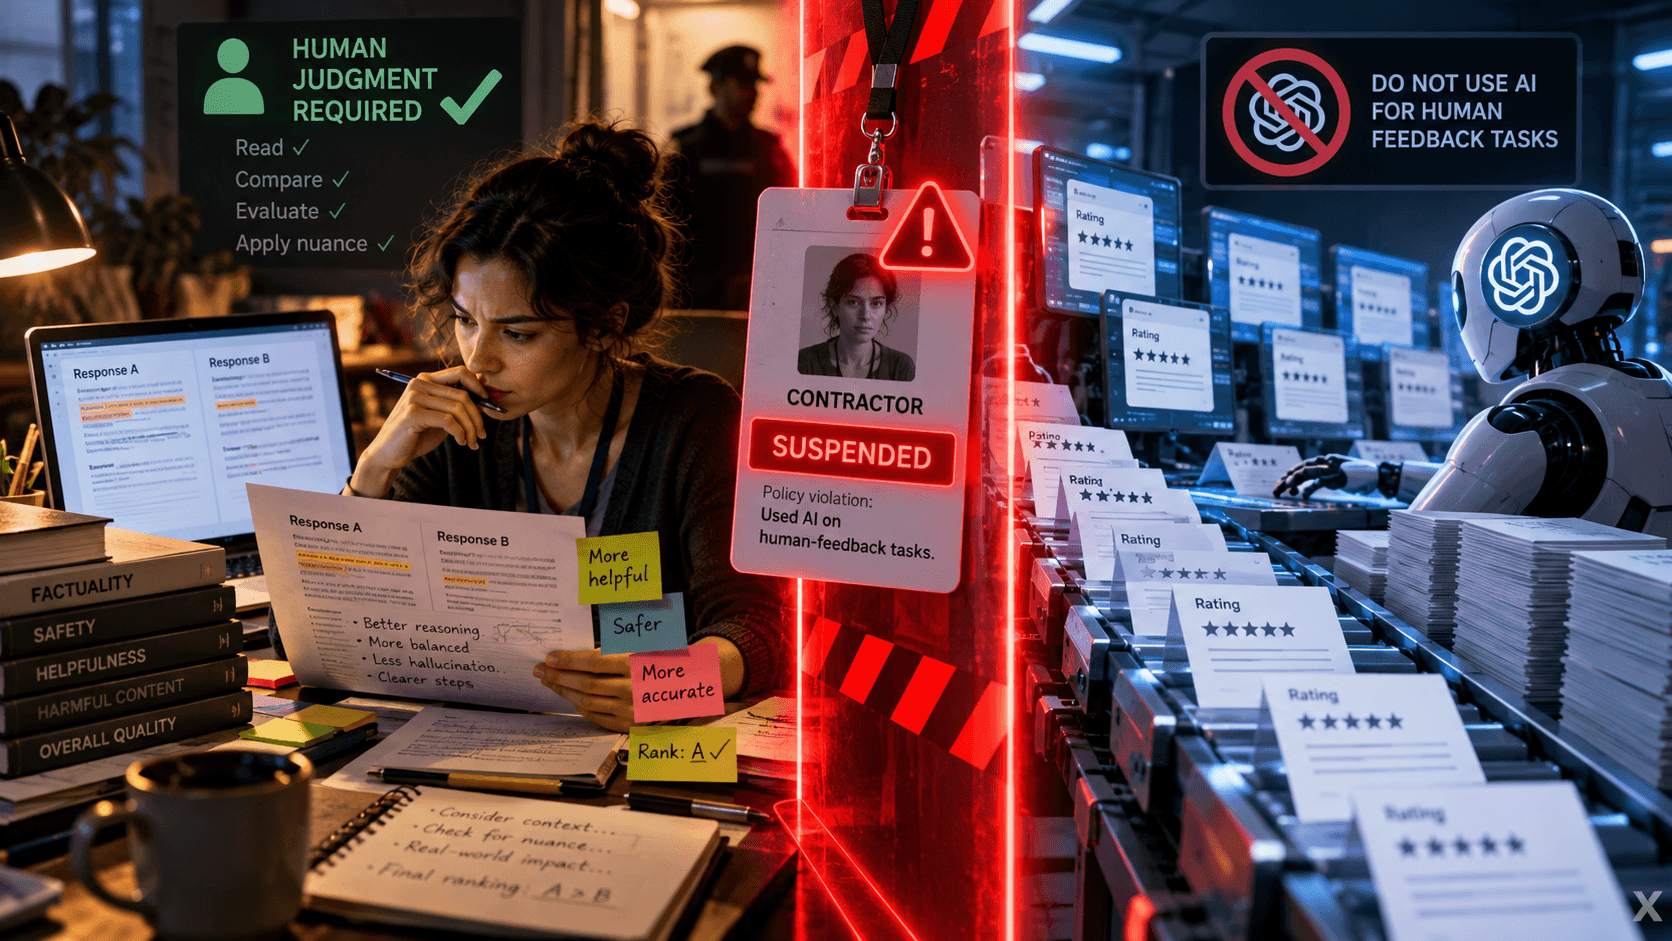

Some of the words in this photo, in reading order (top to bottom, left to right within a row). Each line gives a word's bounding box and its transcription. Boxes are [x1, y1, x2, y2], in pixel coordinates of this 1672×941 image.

[293, 37, 386, 59] HUMAN
[293, 68, 438, 90] JUDGMENT
[1372, 74, 1404, 92] DO
[1412, 74, 1458, 92] NOT
[1466, 74, 1508, 92] USE
[1514, 74, 1536, 92] AI
[293, 99, 422, 124] REQUIRED
[1372, 102, 1415, 120] FOR
[1421, 102, 1502, 120] HUMAN
[236, 138, 284, 156] Read
[1372, 130, 1484, 148] FEEDBACK
[1492, 130, 1558, 148] TASKS
[235, 170, 323, 191] Compare
[236, 202, 319, 220] Evaluate
[1076, 210, 1104, 226] Rating
[236, 234, 290, 255] Apply
[297, 238, 368, 252] nuance
[1131, 328, 1160, 342] Rating
[209, 356, 259, 369] Response
[262, 353, 270, 364] B
[73, 367, 127, 380] Response
[130, 364, 139, 374] A
[787, 389, 923, 415] CONTRACTOR
[772, 435, 932, 470] SUSPENDED
[1069, 475, 1103, 487] Rating
[763, 485, 805, 503] Policy
[809, 489, 873, 508] violation:
[289, 514, 349, 533] Response
[352, 522, 362, 533] A
[761, 507, 798, 524] Used
[803, 511, 819, 526] AI
[822, 516, 841, 528] on
[437, 531, 497, 546] Response
[500, 536, 510, 547] B
[759, 530, 886, 555] human-feedback
[890, 541, 935, 560] tasks.
[1121, 533, 1161, 548] Rating
[589, 548, 629, 564] More
[589, 564, 648, 591] helpful
[31, 573, 134, 603] FACTUALITY
[1195, 597, 1240, 612] Rating
[34, 619, 96, 643] SAFETY
[363, 617, 407, 631] Better
[613, 614, 662, 637] Safer
[369, 636, 404, 649] More
[409, 638, 470, 653] balanced
[36, 648, 147, 682] HELPFULNESS
[372, 653, 402, 666] Less
[378, 671, 427, 684] Clearer
[435, 676, 474, 690] steps
[642, 664, 685, 681] More
[37, 693, 112, 720] HARMFUL
[115, 678, 184, 704] CONTENT
[642, 682, 715, 703] accurate
[1288, 688, 1338, 703] Rating
[39, 731, 110, 759] OVERALL
[113, 717, 177, 744] QUALITY
[638, 744, 685, 760] Rank:
[439, 807, 514, 823] Consider
[1384, 806, 1446, 824] Rating
[424, 824, 473, 838] Check
[482, 829, 513, 843] for
[404, 840, 514, 863] Real-world
[377, 862, 434, 881] Final
[594, 888, 611, 903] B
